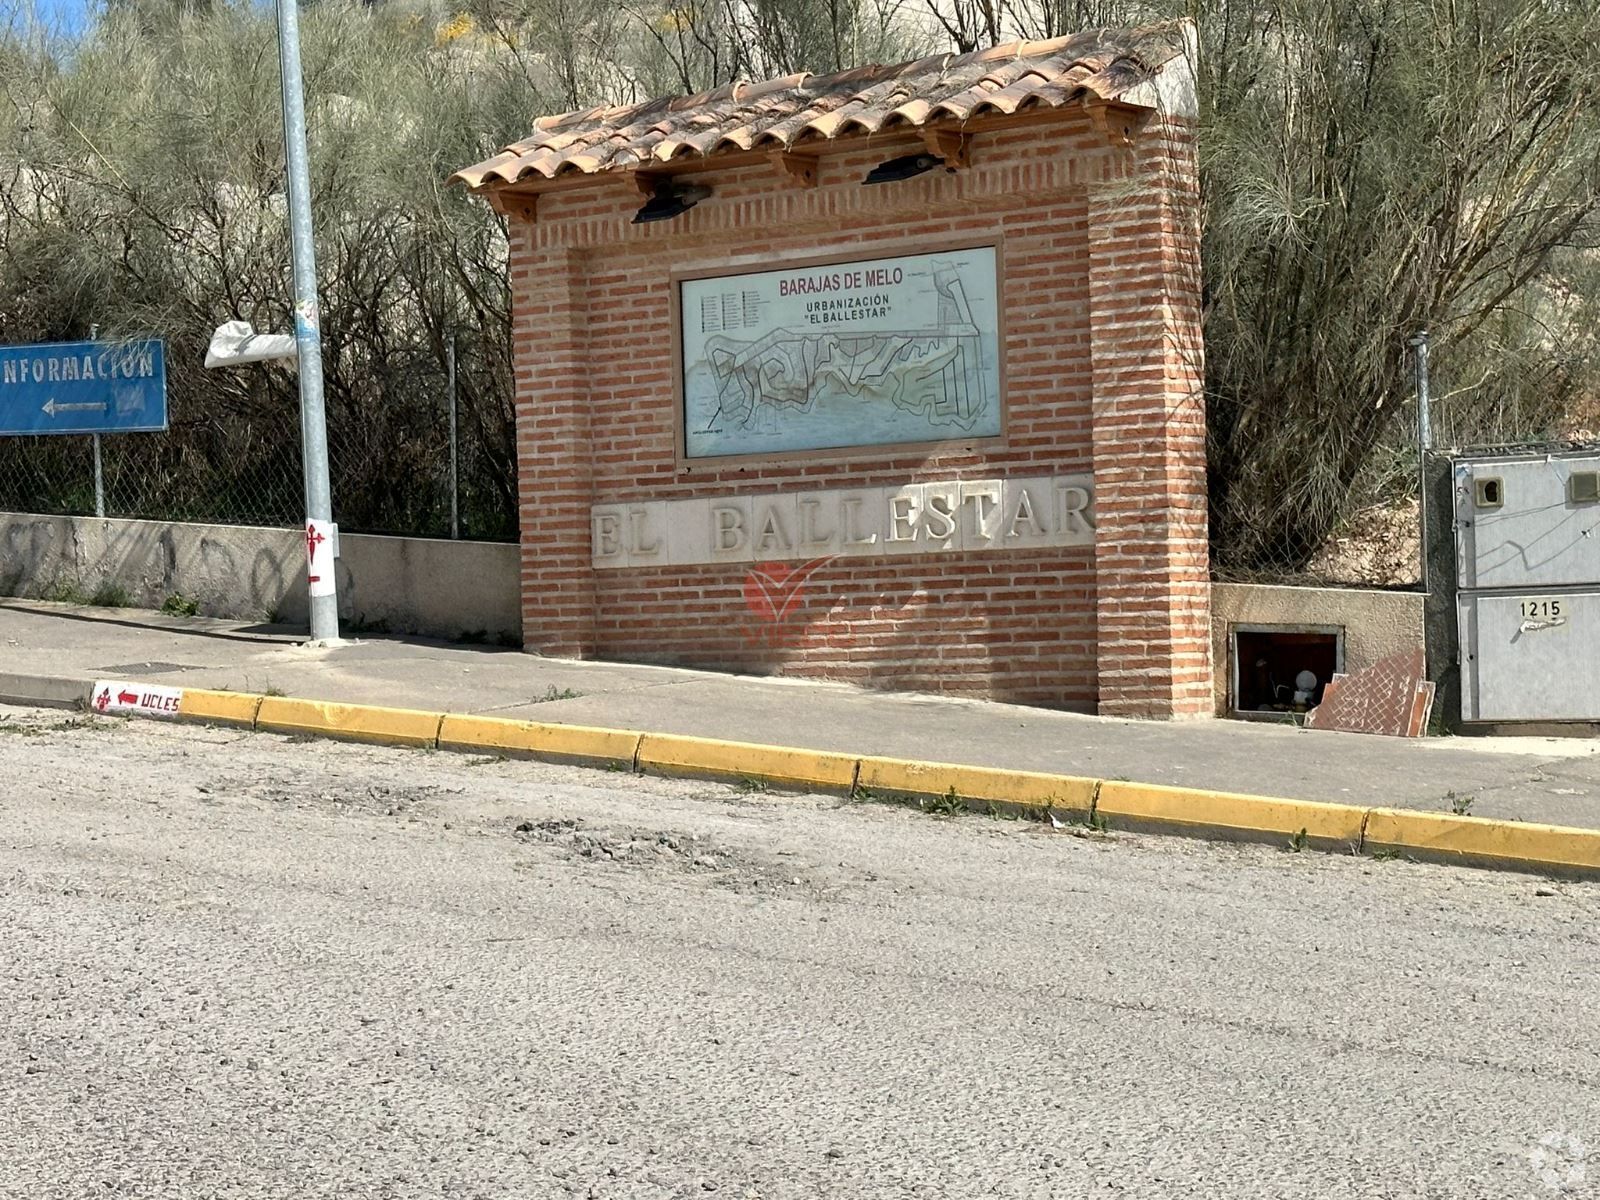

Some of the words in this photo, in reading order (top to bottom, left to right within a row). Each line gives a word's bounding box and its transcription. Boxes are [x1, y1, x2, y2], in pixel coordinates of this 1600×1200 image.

[780, 274, 841, 296] BARAJAS
[844, 272, 862, 289] DE
[866, 267, 903, 287] MELO
[806, 293, 889, 312] URBANIZACIÓN
[593, 512, 660, 559] EL
[712, 485, 1094, 552] BALLESTAR
[1520, 601, 1561, 617] 1215
[141, 693, 180, 712] UCLES
